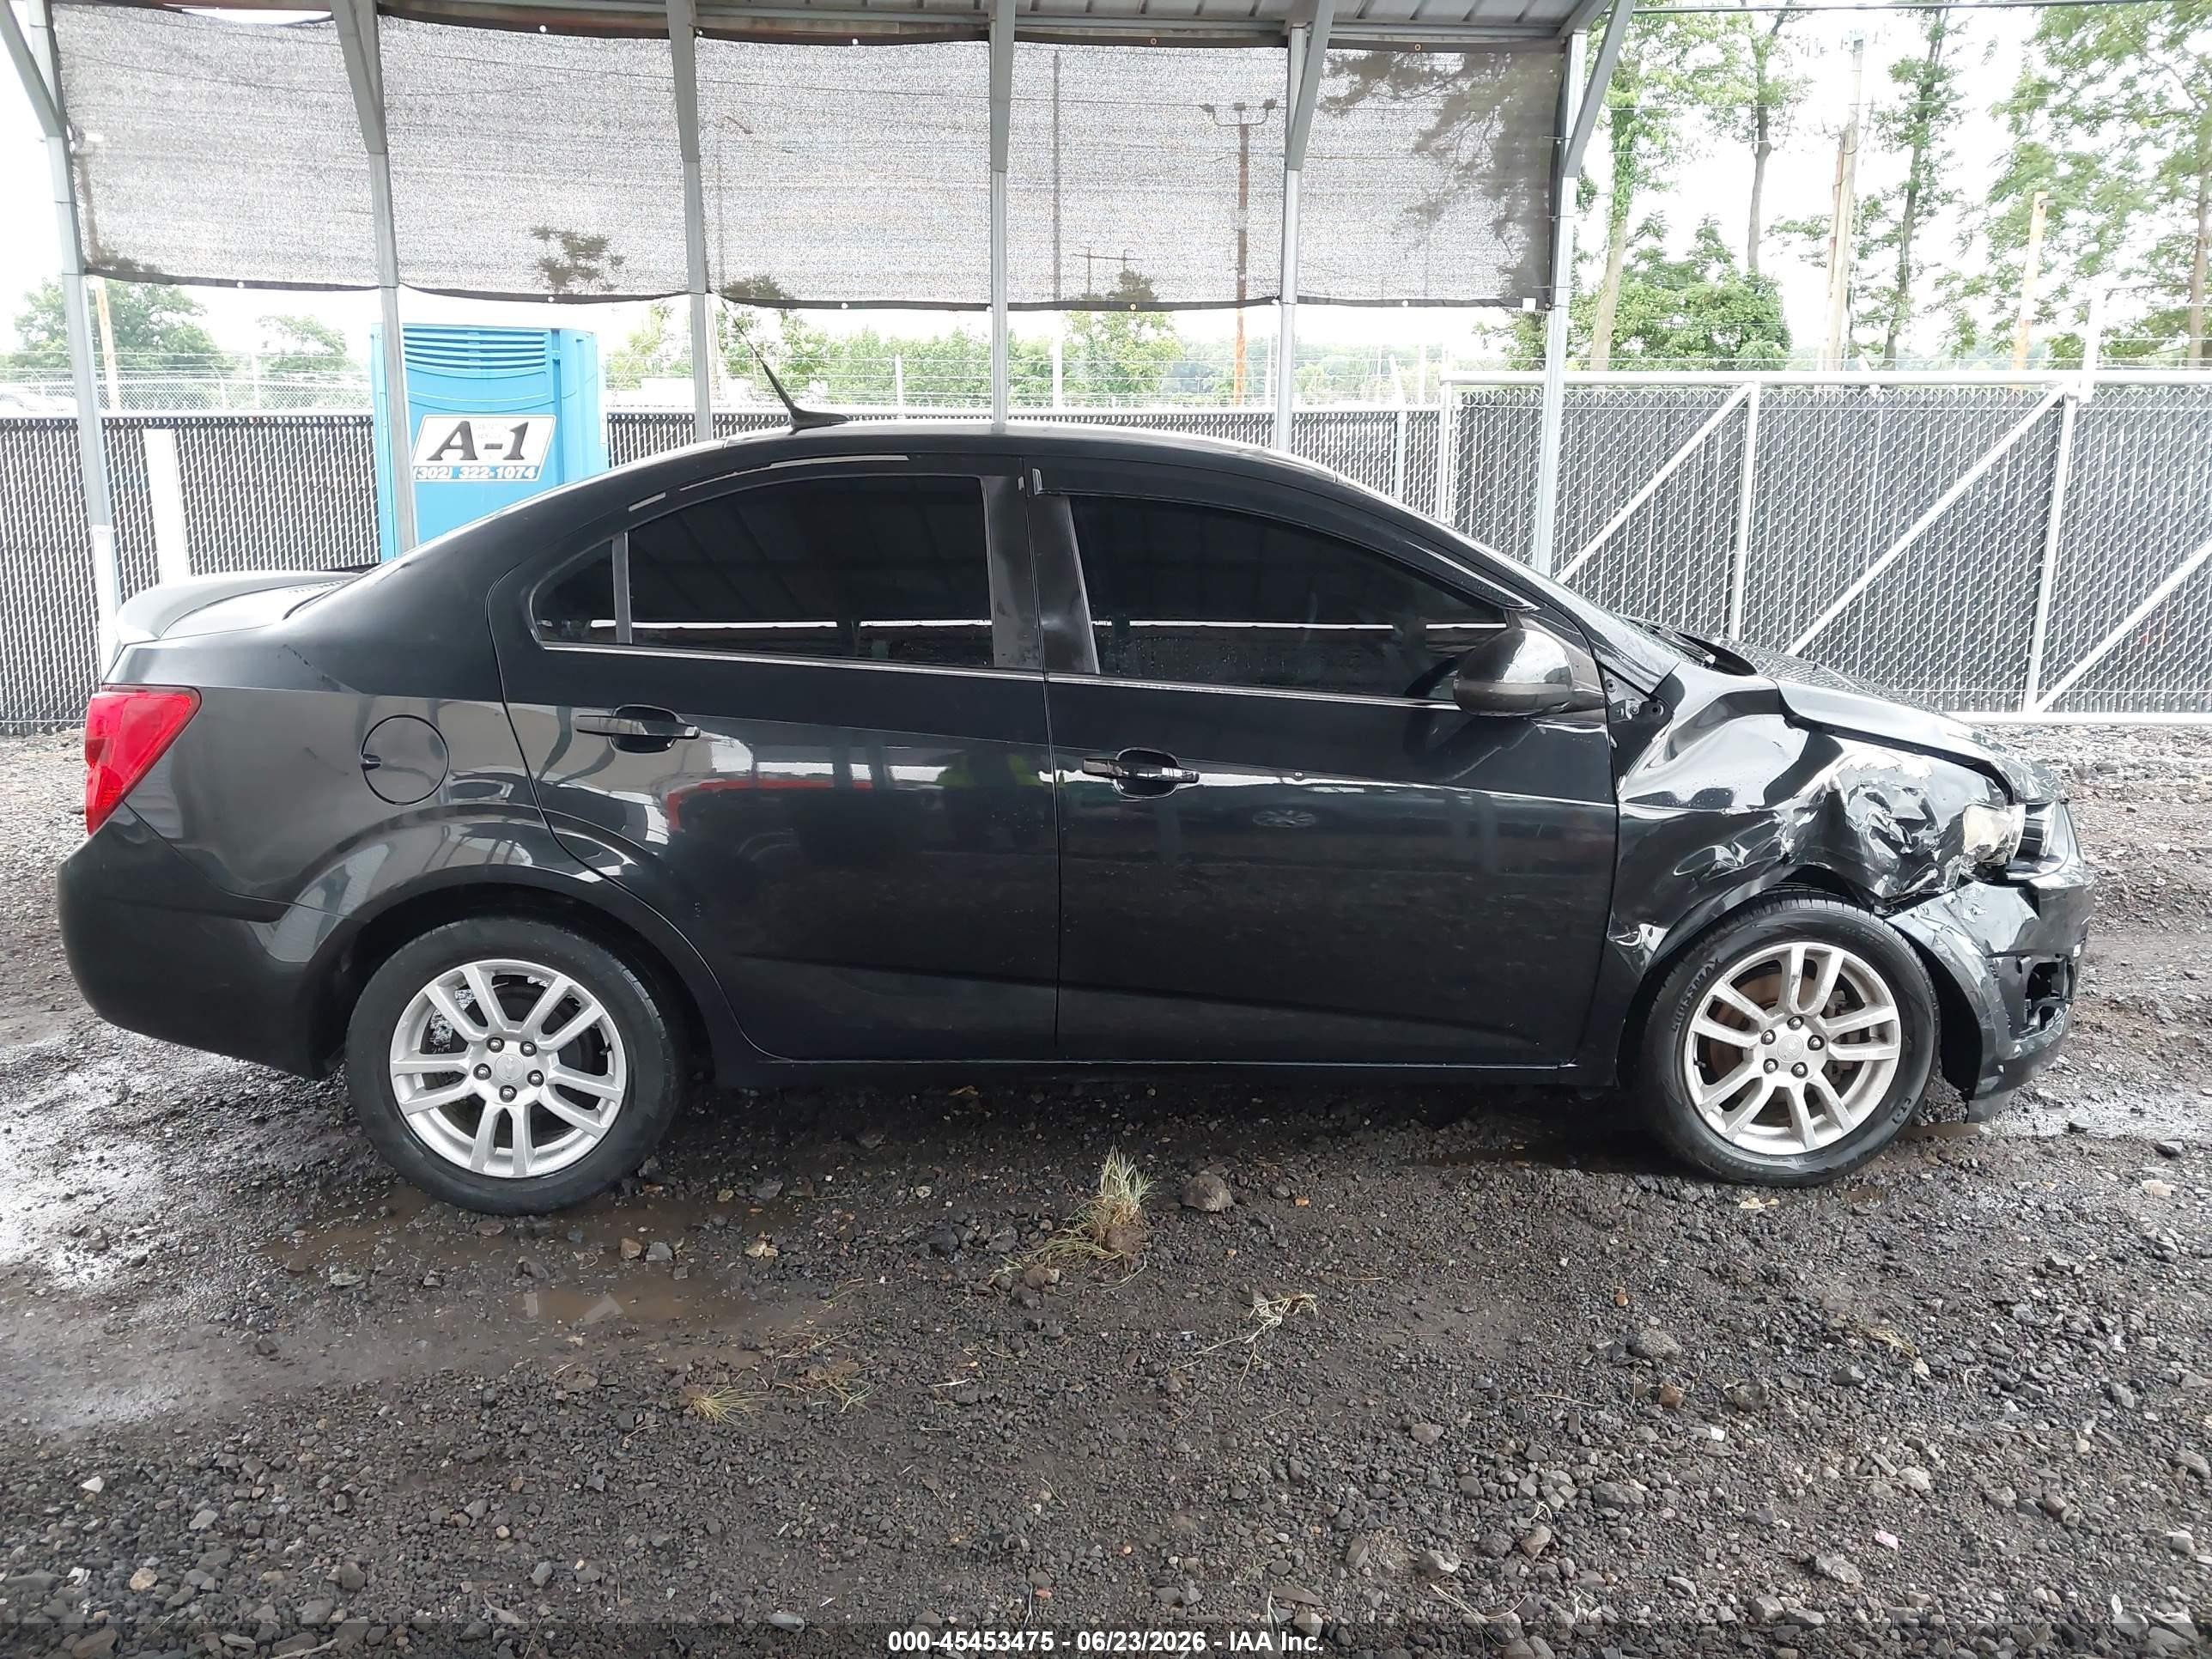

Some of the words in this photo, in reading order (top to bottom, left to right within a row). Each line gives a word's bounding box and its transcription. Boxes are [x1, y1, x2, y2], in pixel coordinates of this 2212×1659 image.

[427, 421, 529, 461] A-1
[413, 466, 453, 480] (302)
[459, 466, 537, 480] 322-1074
